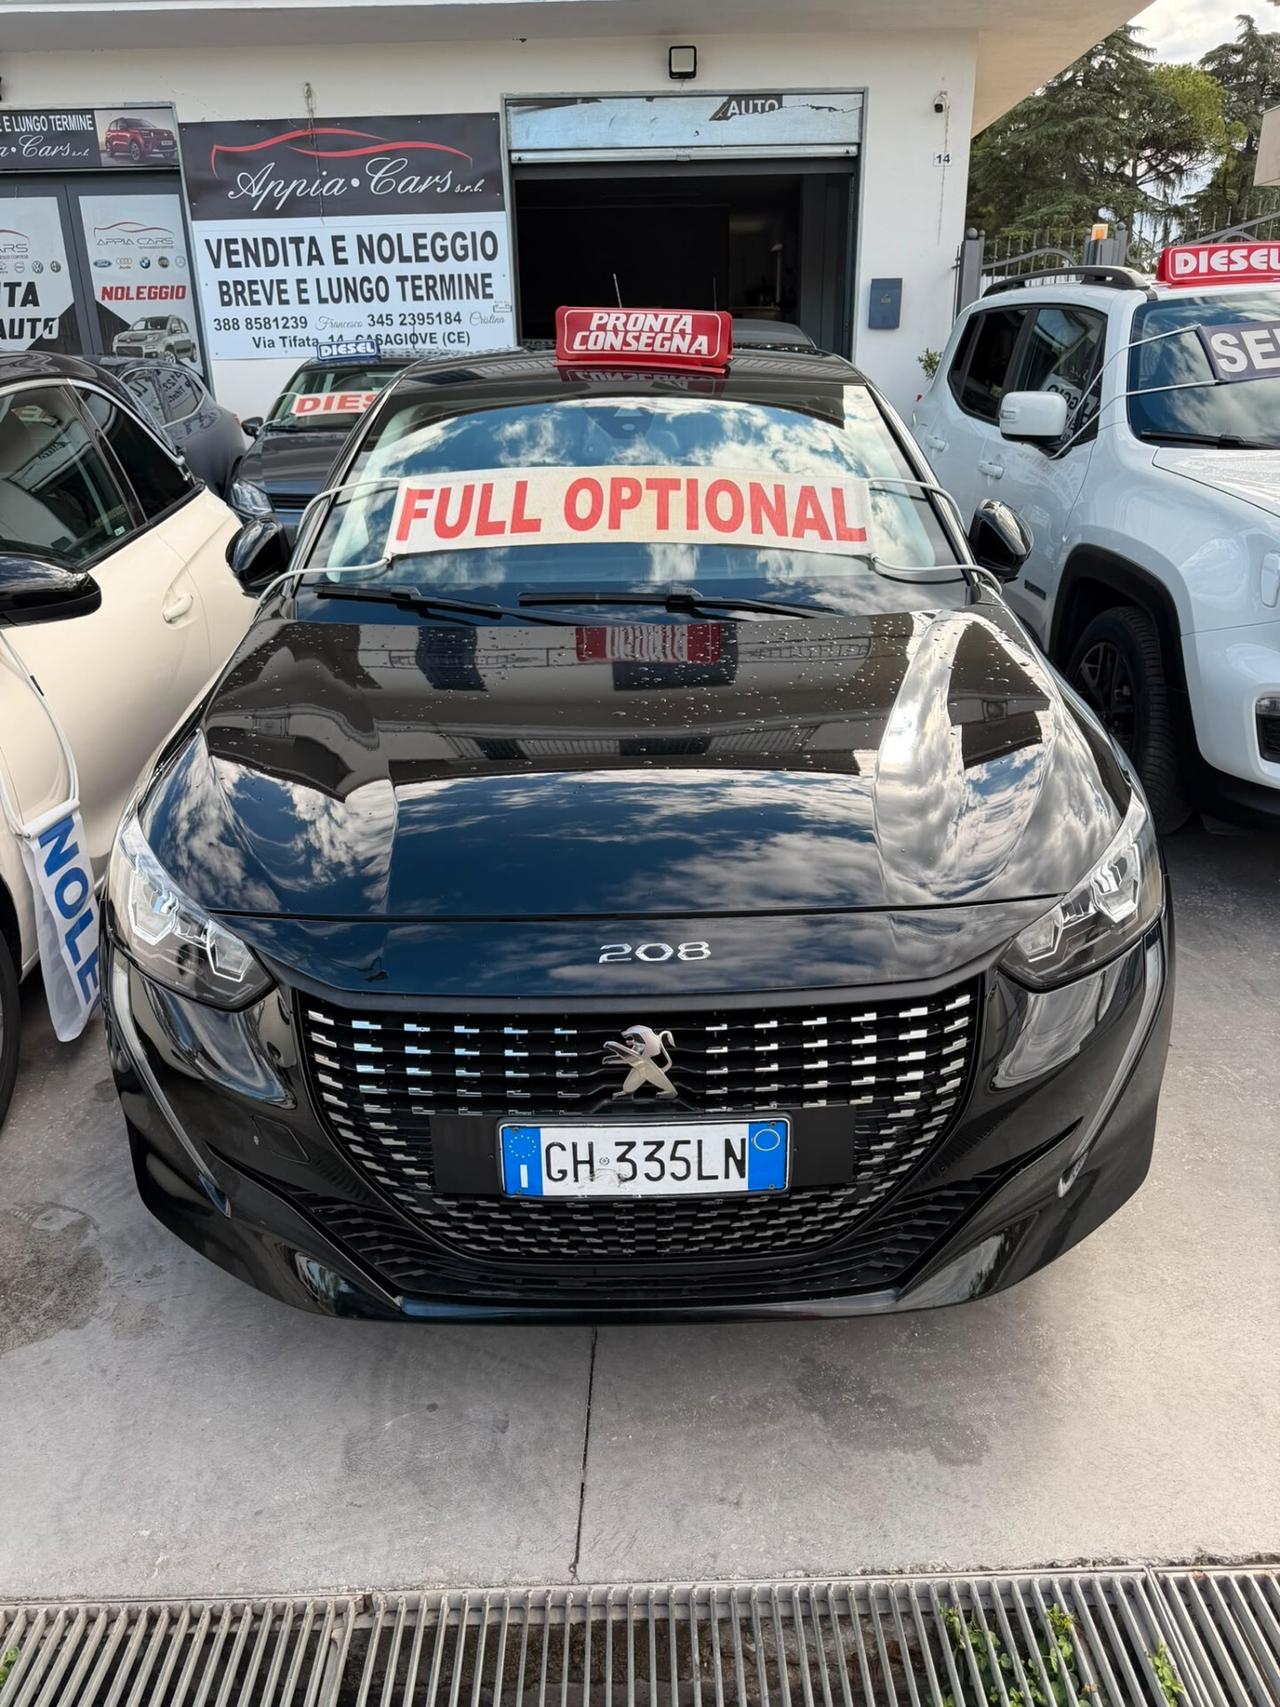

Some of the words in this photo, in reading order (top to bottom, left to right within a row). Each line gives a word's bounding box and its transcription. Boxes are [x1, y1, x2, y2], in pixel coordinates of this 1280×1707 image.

[727, 99, 779, 116] AUTO
[2, 116, 12, 132] E
[12, 115, 48, 132] LUNGO
[49, 114, 94, 131] TERMINE
[935, 153, 951, 164] 14
[454, 178, 483, 193] s.r.l.
[96, 237, 135, 246] APPIA
[136, 236, 174, 245] CARS
[204, 235, 325, 269] VENDITA
[330, 234, 349, 265] E
[356, 230, 499, 265] NOLEGGIO
[0, 281, 40, 308] TA
[101, 284, 187, 301] NOLEGGIO
[217, 278, 291, 307] BREVE
[295, 277, 310, 305] E
[315, 275, 391, 305] LUNGO
[395, 272, 494, 302] TERMINE
[213, 317, 240, 331] 388
[245, 316, 308, 331] 8581239
[367, 313, 394, 327] 345
[398, 311, 462, 327] 2395184
[589, 312, 693, 334] PRONTA
[252, 336, 275, 349] Via
[442, 330, 470, 347] (CE)
[320, 341, 375, 357] DIESEL
[572, 331, 709, 355] CONSEGNA
[1210, 328, 1280, 373] SE
[395, 480, 542, 541] FULL
[563, 477, 867, 542] OPTIONAL
[38, 815, 100, 1008] NOLE
[598, 941, 712, 963] 208
